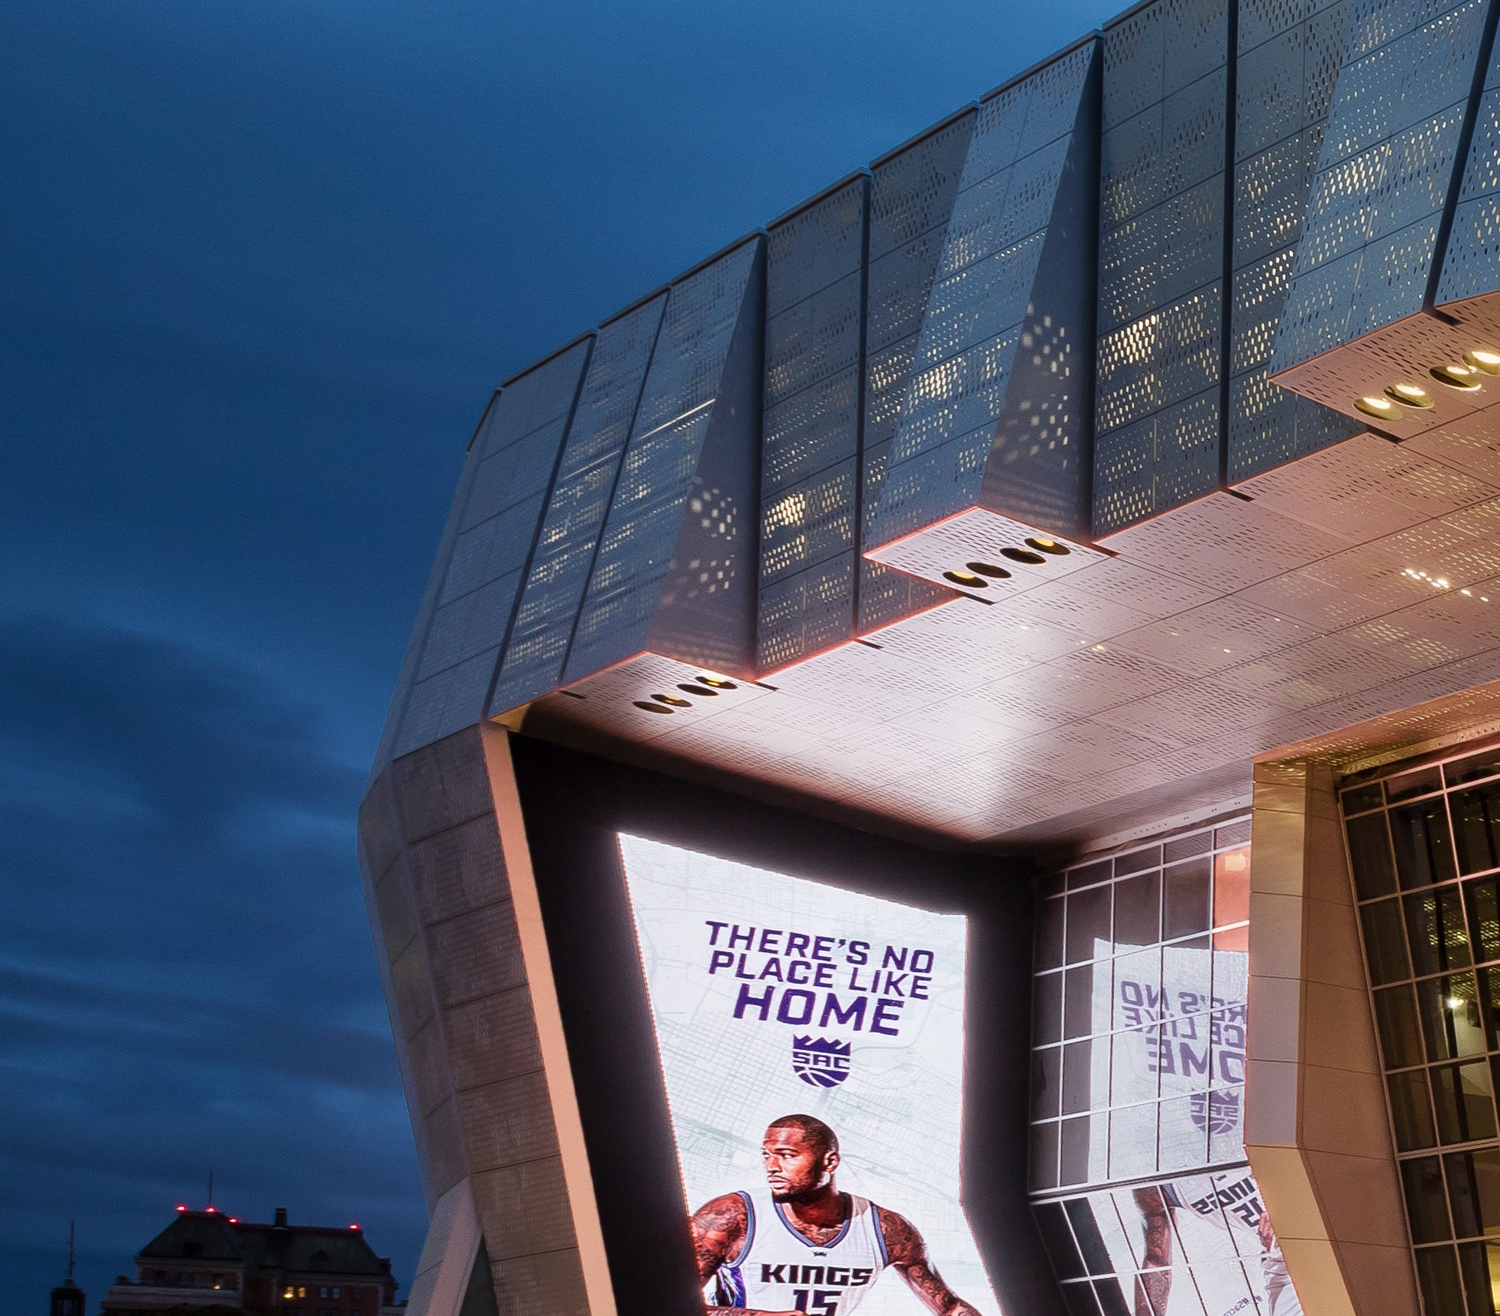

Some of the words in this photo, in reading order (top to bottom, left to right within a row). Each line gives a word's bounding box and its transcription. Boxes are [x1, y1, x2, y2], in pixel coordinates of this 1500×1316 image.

[705, 920, 871, 966] THERE'S
[882, 945, 934, 974] NO
[708, 950, 837, 989] PLACE
[848, 967, 933, 1000] LIKE
[733, 983, 904, 1036] HOME
[793, 1051, 850, 1070] SAC
[761, 1264, 873, 1286] KINGS
